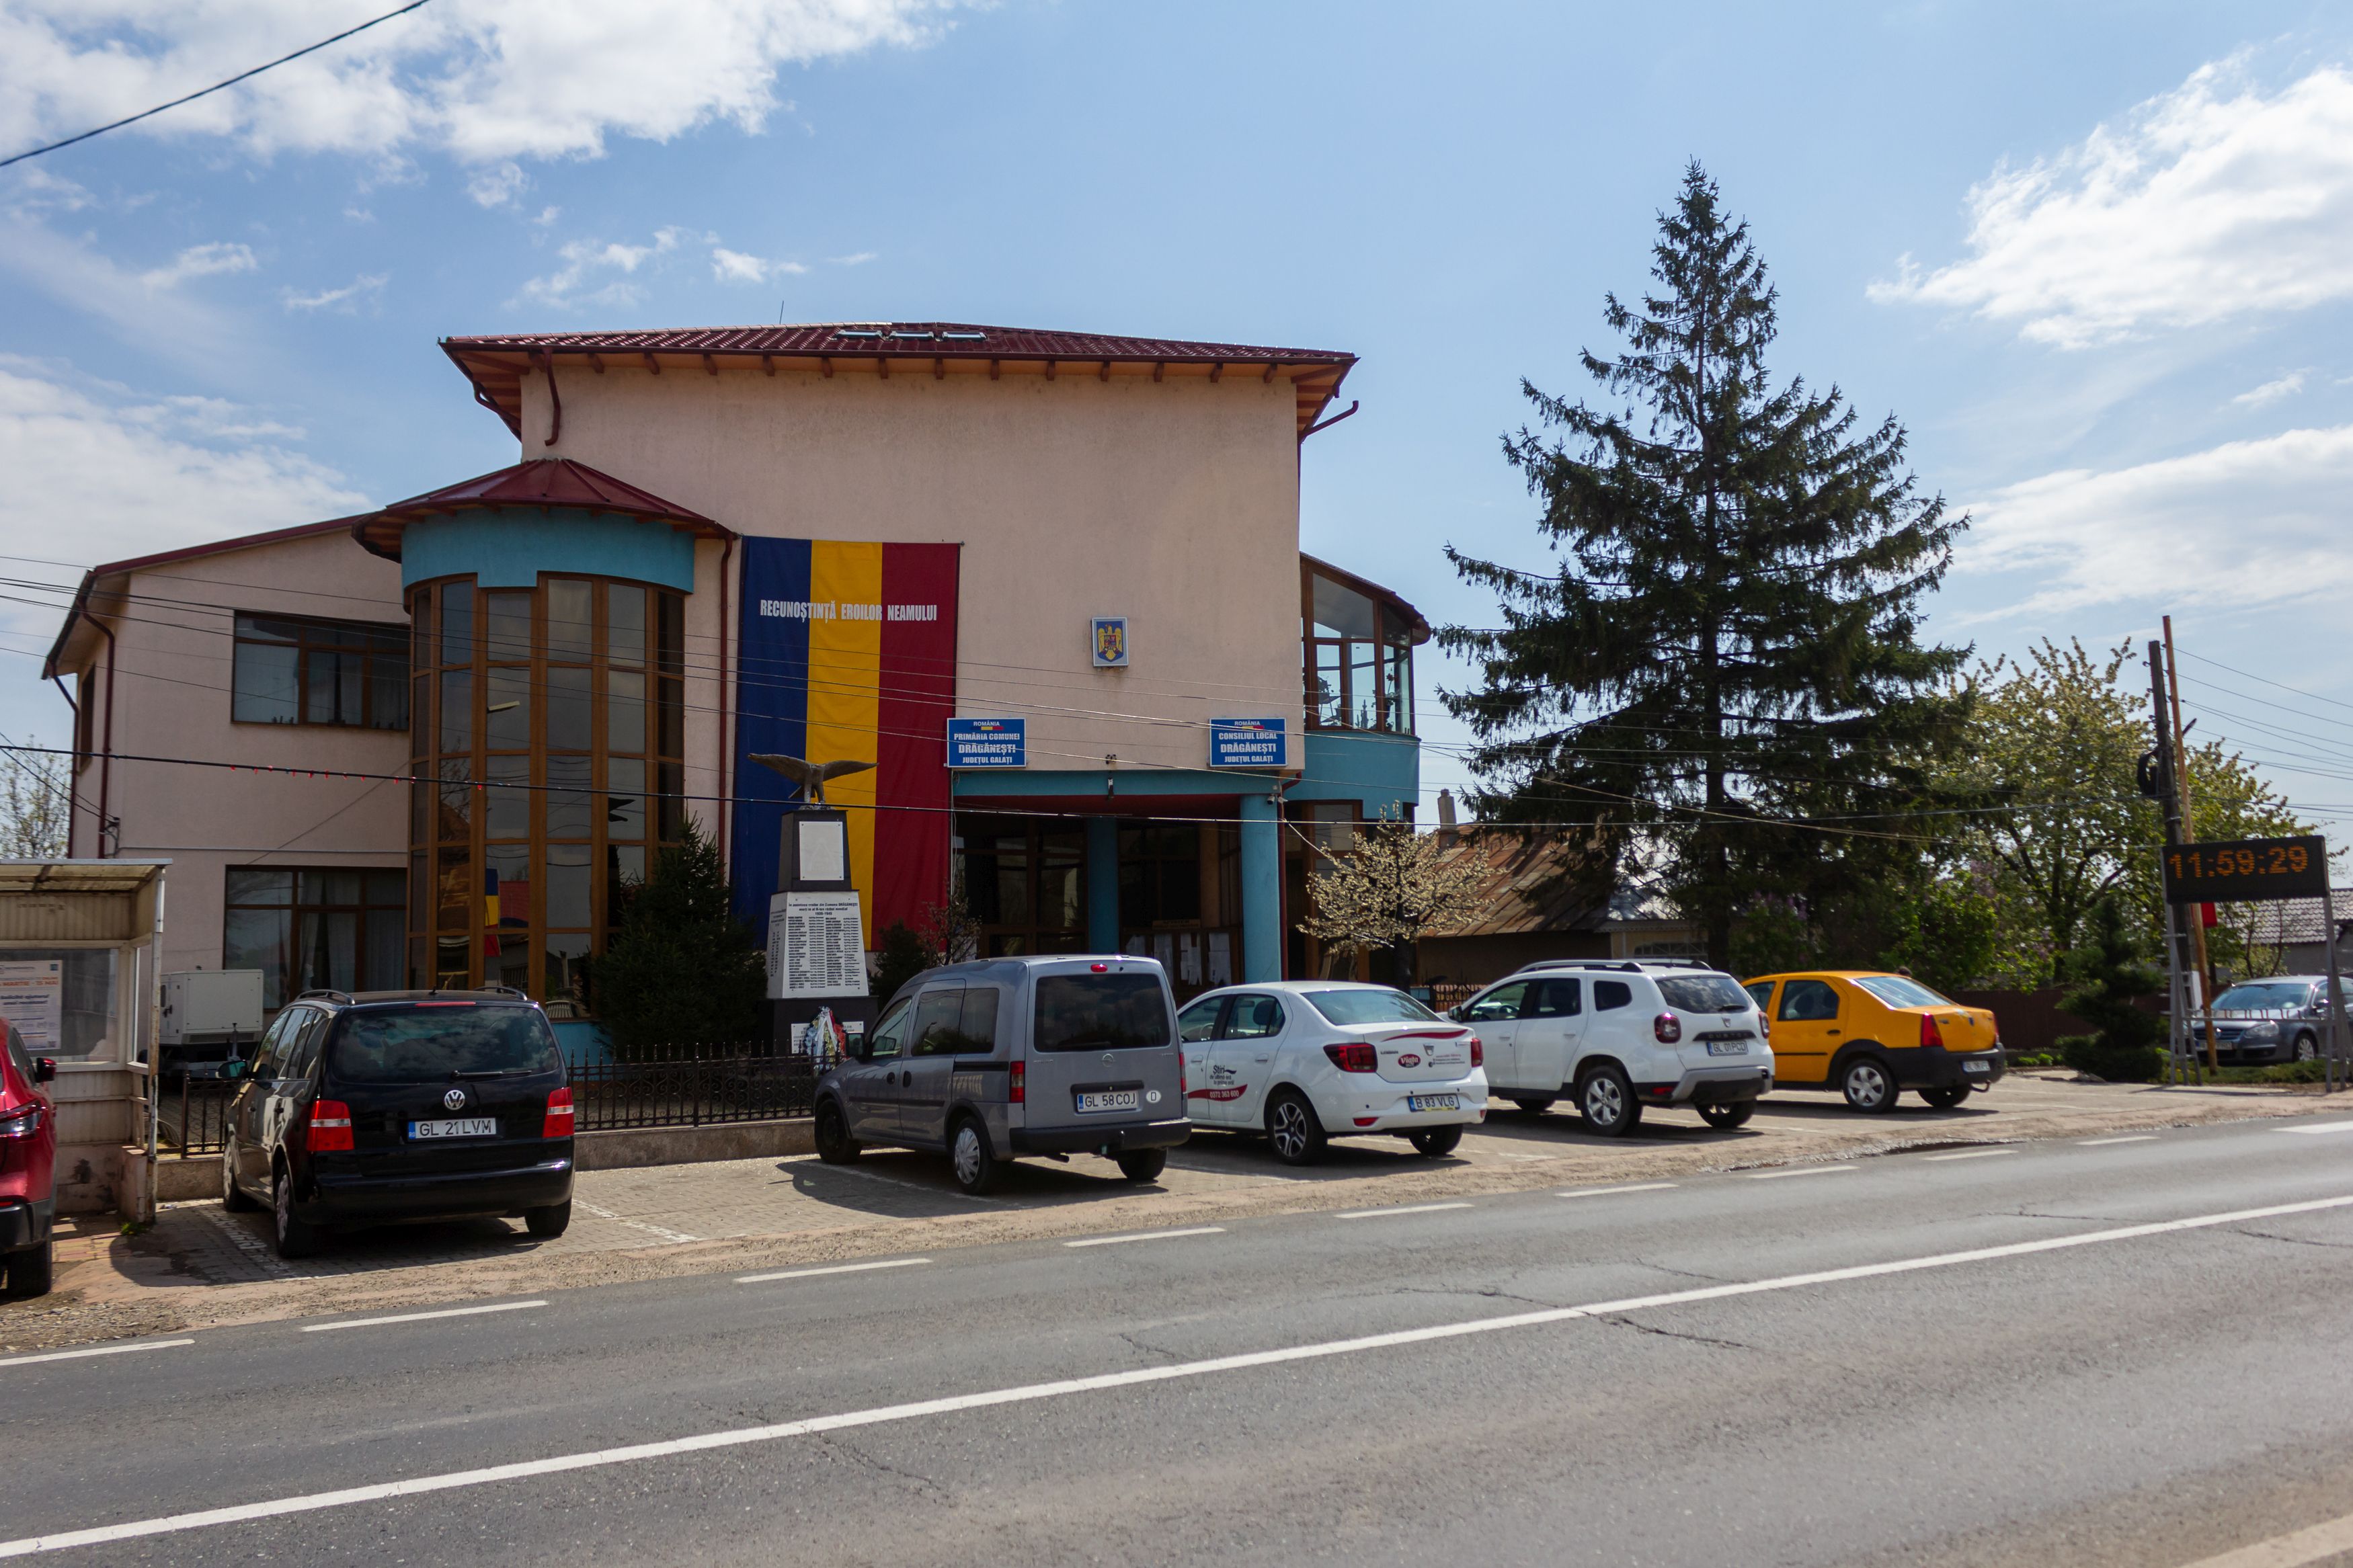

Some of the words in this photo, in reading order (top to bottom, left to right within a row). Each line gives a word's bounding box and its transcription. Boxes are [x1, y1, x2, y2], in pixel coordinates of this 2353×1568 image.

[760, 600, 836, 623] RECUNOȘTINȚĂ
[841, 604, 882, 620] EROILOR
[887, 604, 937, 621] NEAMULUI
[963, 757, 989, 765] JUDEȚUL
[1251, 755, 1273, 764] GALAȚI
[2168, 845, 2308, 879] 11:59:29
[1085, 1096, 1099, 1107] GL
[1416, 1098, 1423, 1108] B
[1425, 1097, 1435, 1108] 83
[1437, 1097, 1455, 1107] VLG
[420, 1123, 439, 1136] GL
